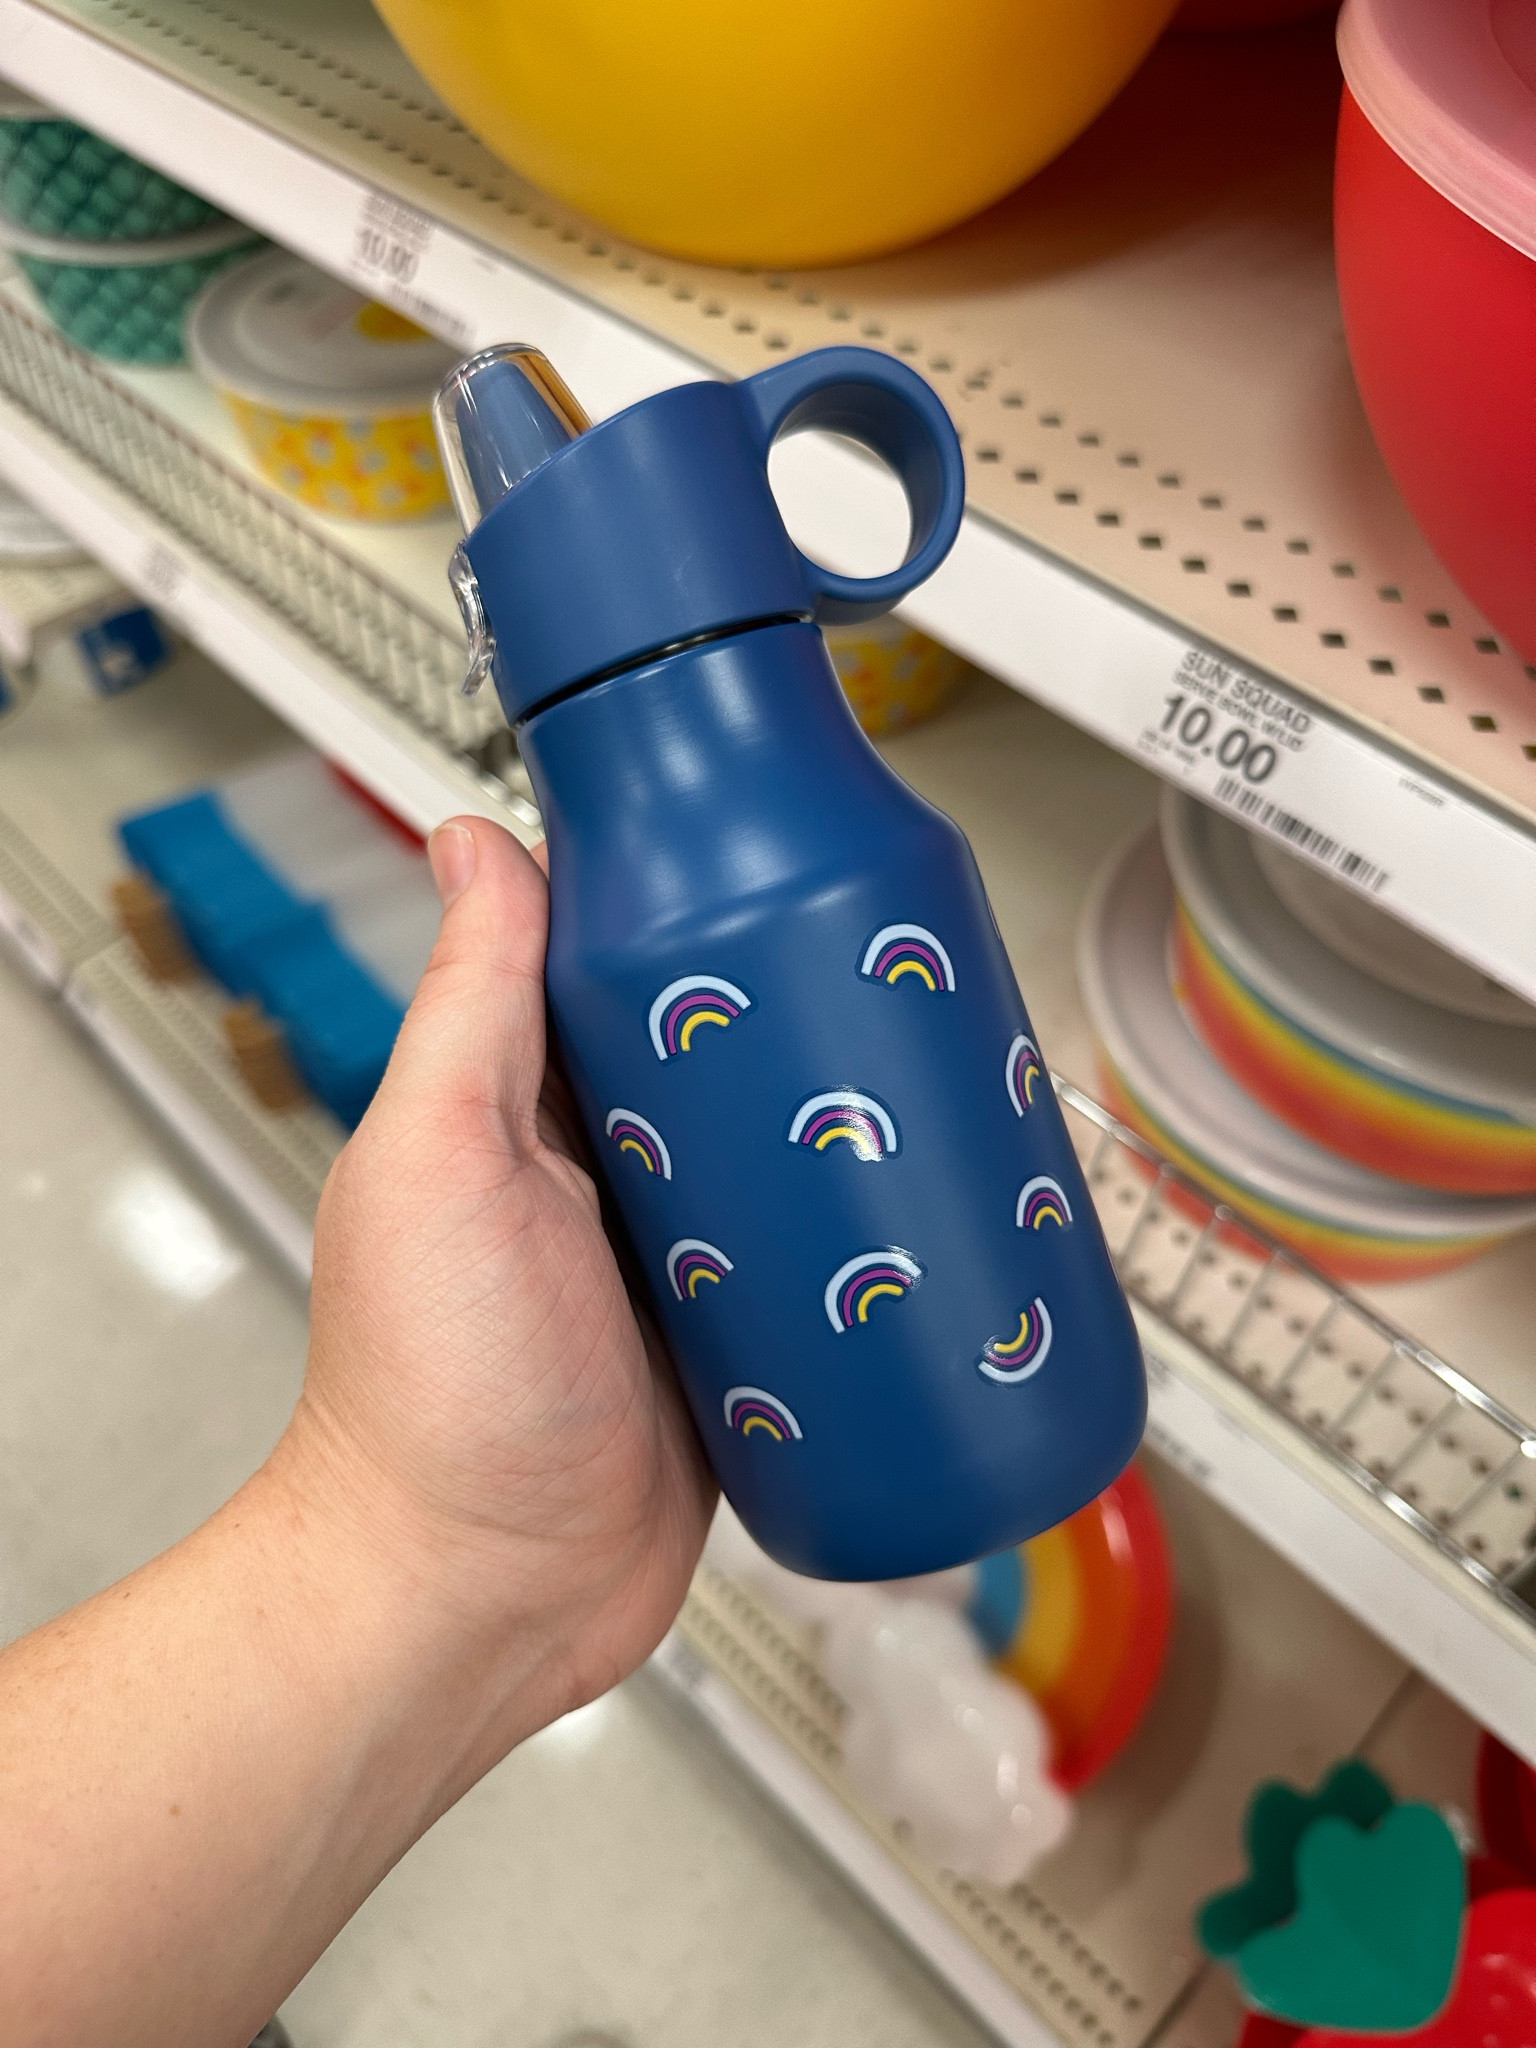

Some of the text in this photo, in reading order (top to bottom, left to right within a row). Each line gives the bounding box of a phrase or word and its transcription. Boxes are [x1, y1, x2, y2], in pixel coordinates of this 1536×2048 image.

[1181, 651, 1311, 735] SUN SQUAD
[1163, 694, 1276, 785] 10.00
